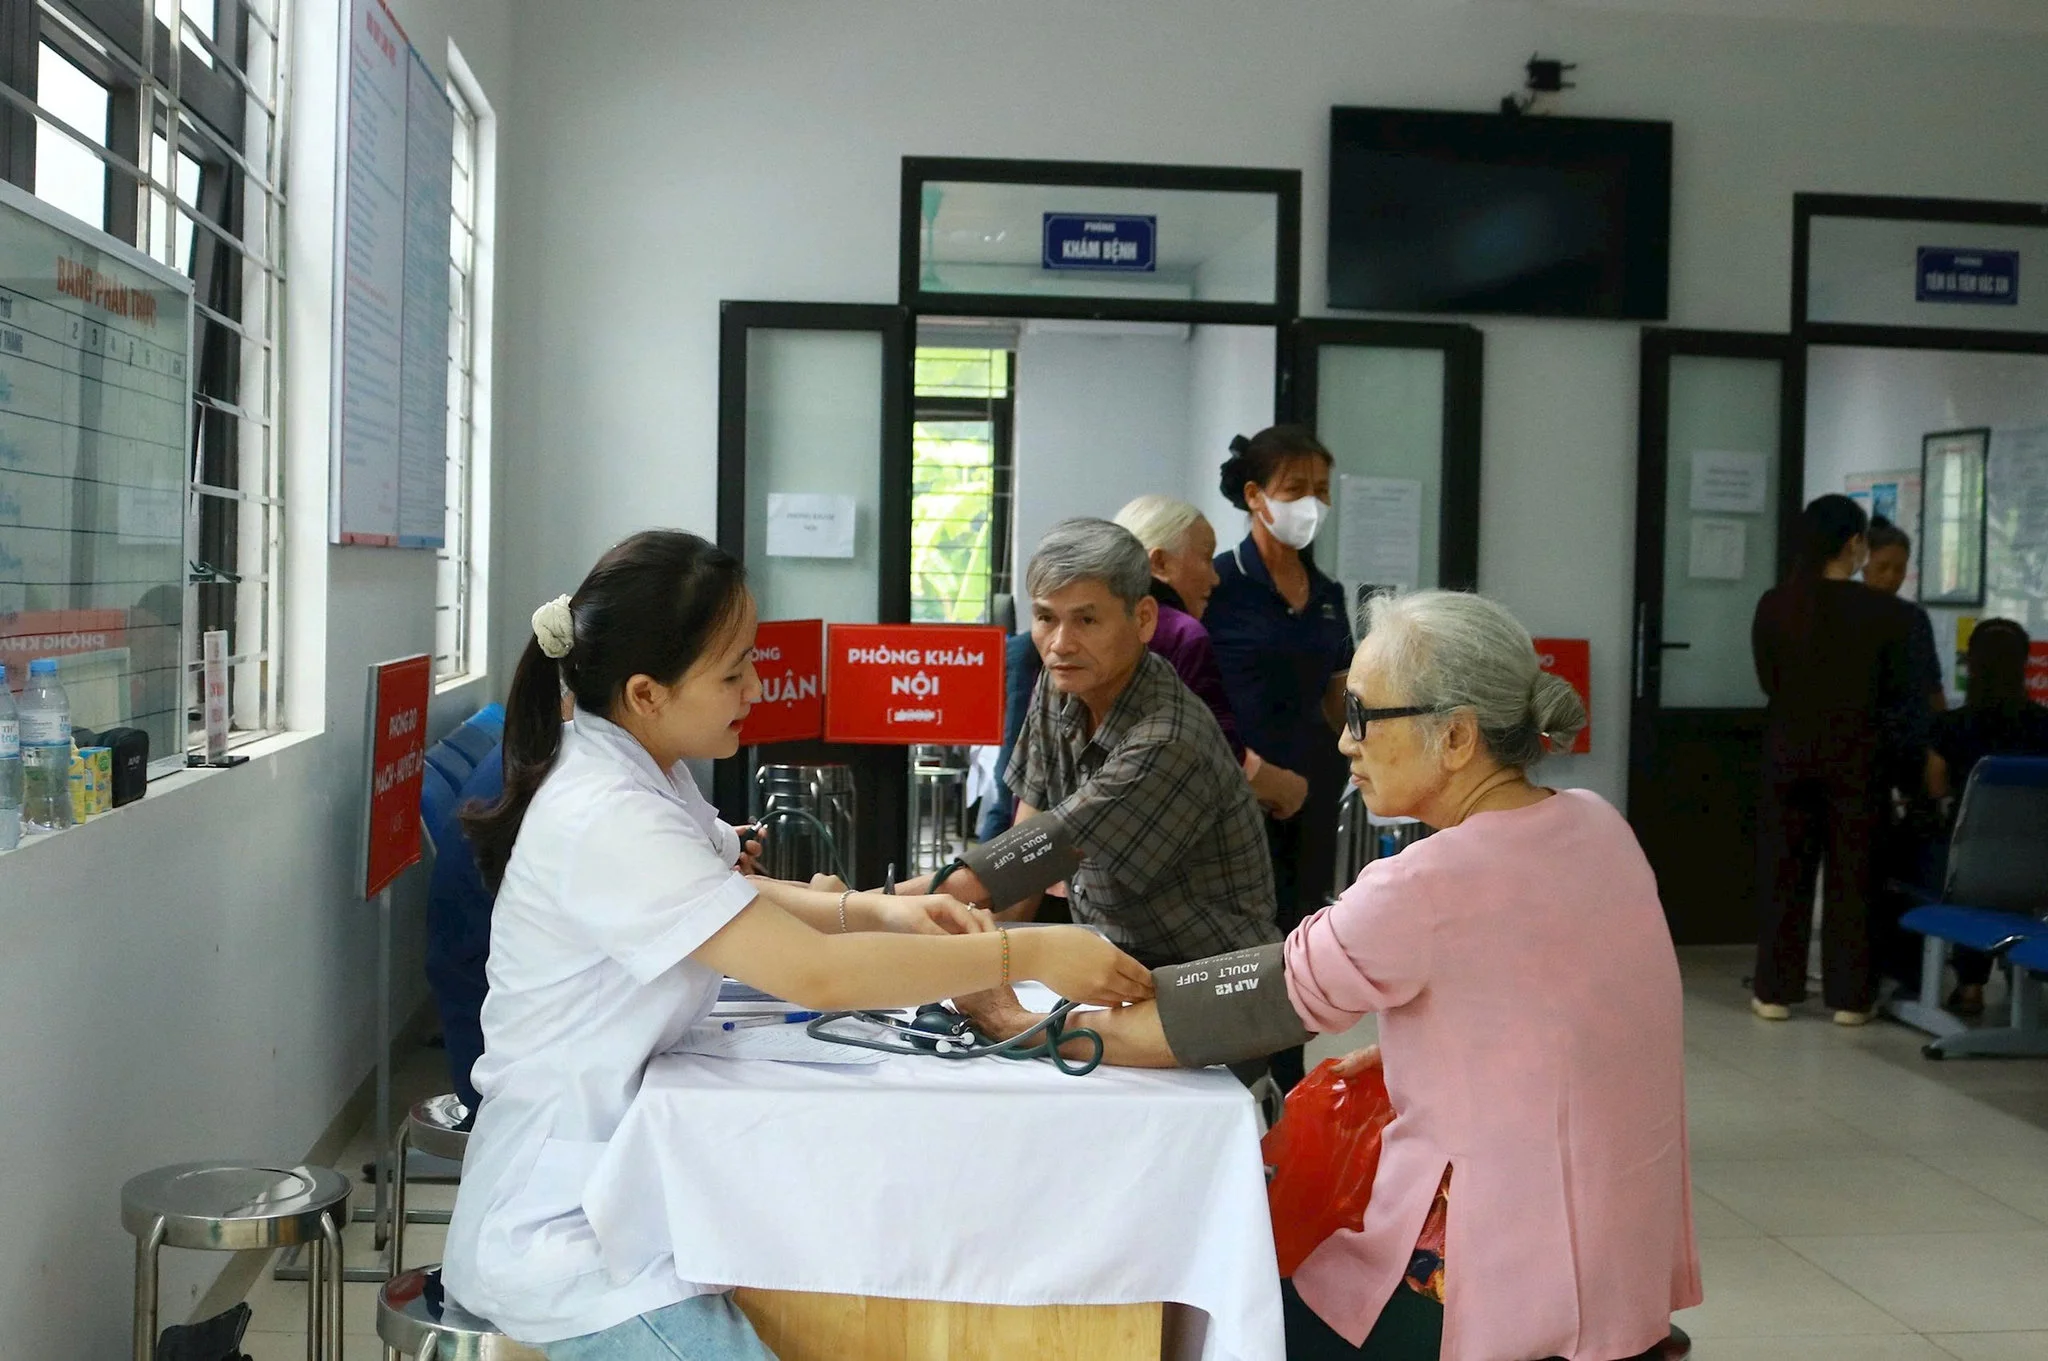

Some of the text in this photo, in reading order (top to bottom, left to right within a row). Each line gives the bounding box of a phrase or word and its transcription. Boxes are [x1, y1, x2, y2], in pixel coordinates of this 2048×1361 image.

[1063, 236, 1100, 258] KHÁM
[749, 646, 781, 662] ÒNG
[848, 645, 984, 666] PHÒNG KHÁM
[750, 669, 817, 708] UẬN
[891, 670, 940, 701] NỘI
[1020, 832, 1048, 853] ADULT
[1176, 971, 1209, 987] CUFF
[1218, 962, 1260, 978] ADULT
